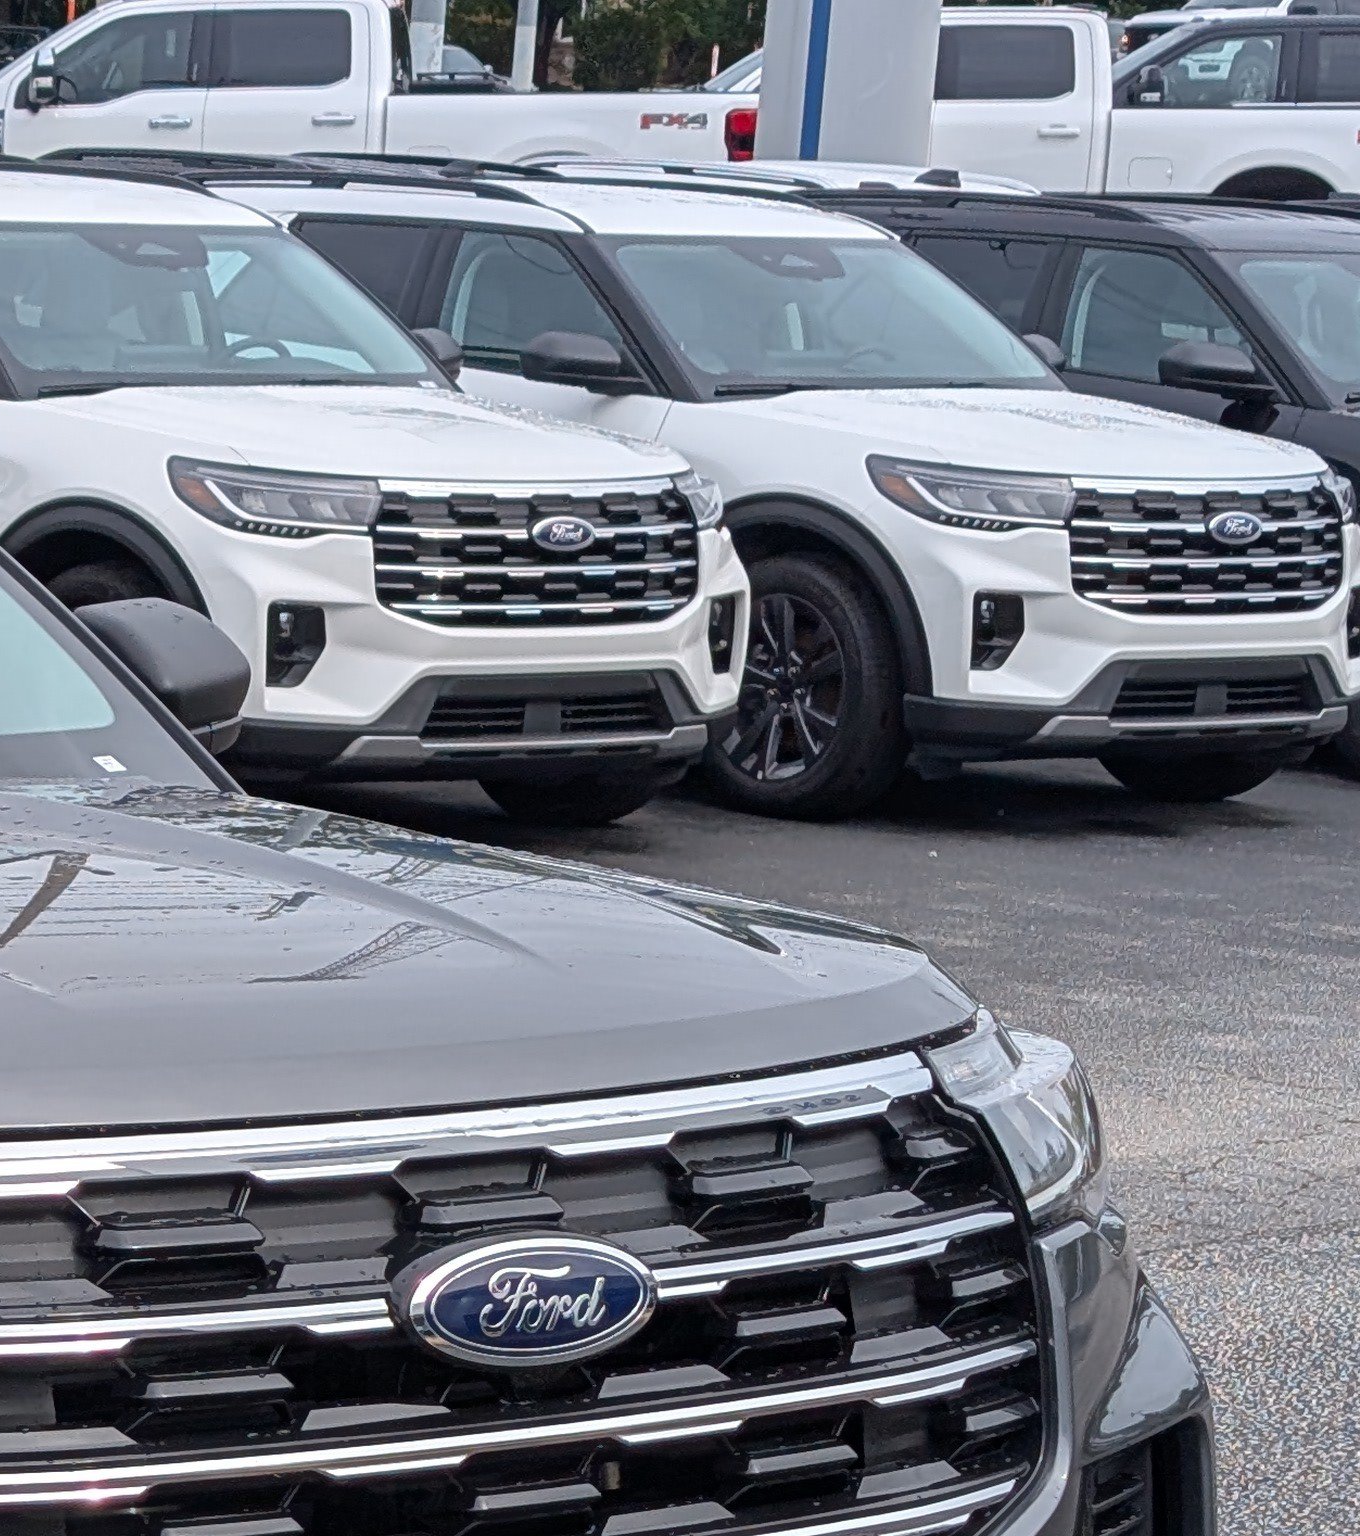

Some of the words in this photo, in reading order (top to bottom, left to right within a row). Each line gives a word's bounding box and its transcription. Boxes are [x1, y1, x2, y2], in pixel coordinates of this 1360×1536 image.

[640, 112, 708, 130] FX4
[549, 523, 584, 543] Ford
[1223, 518, 1254, 535] Ford
[480, 1265, 606, 1338] Ford
